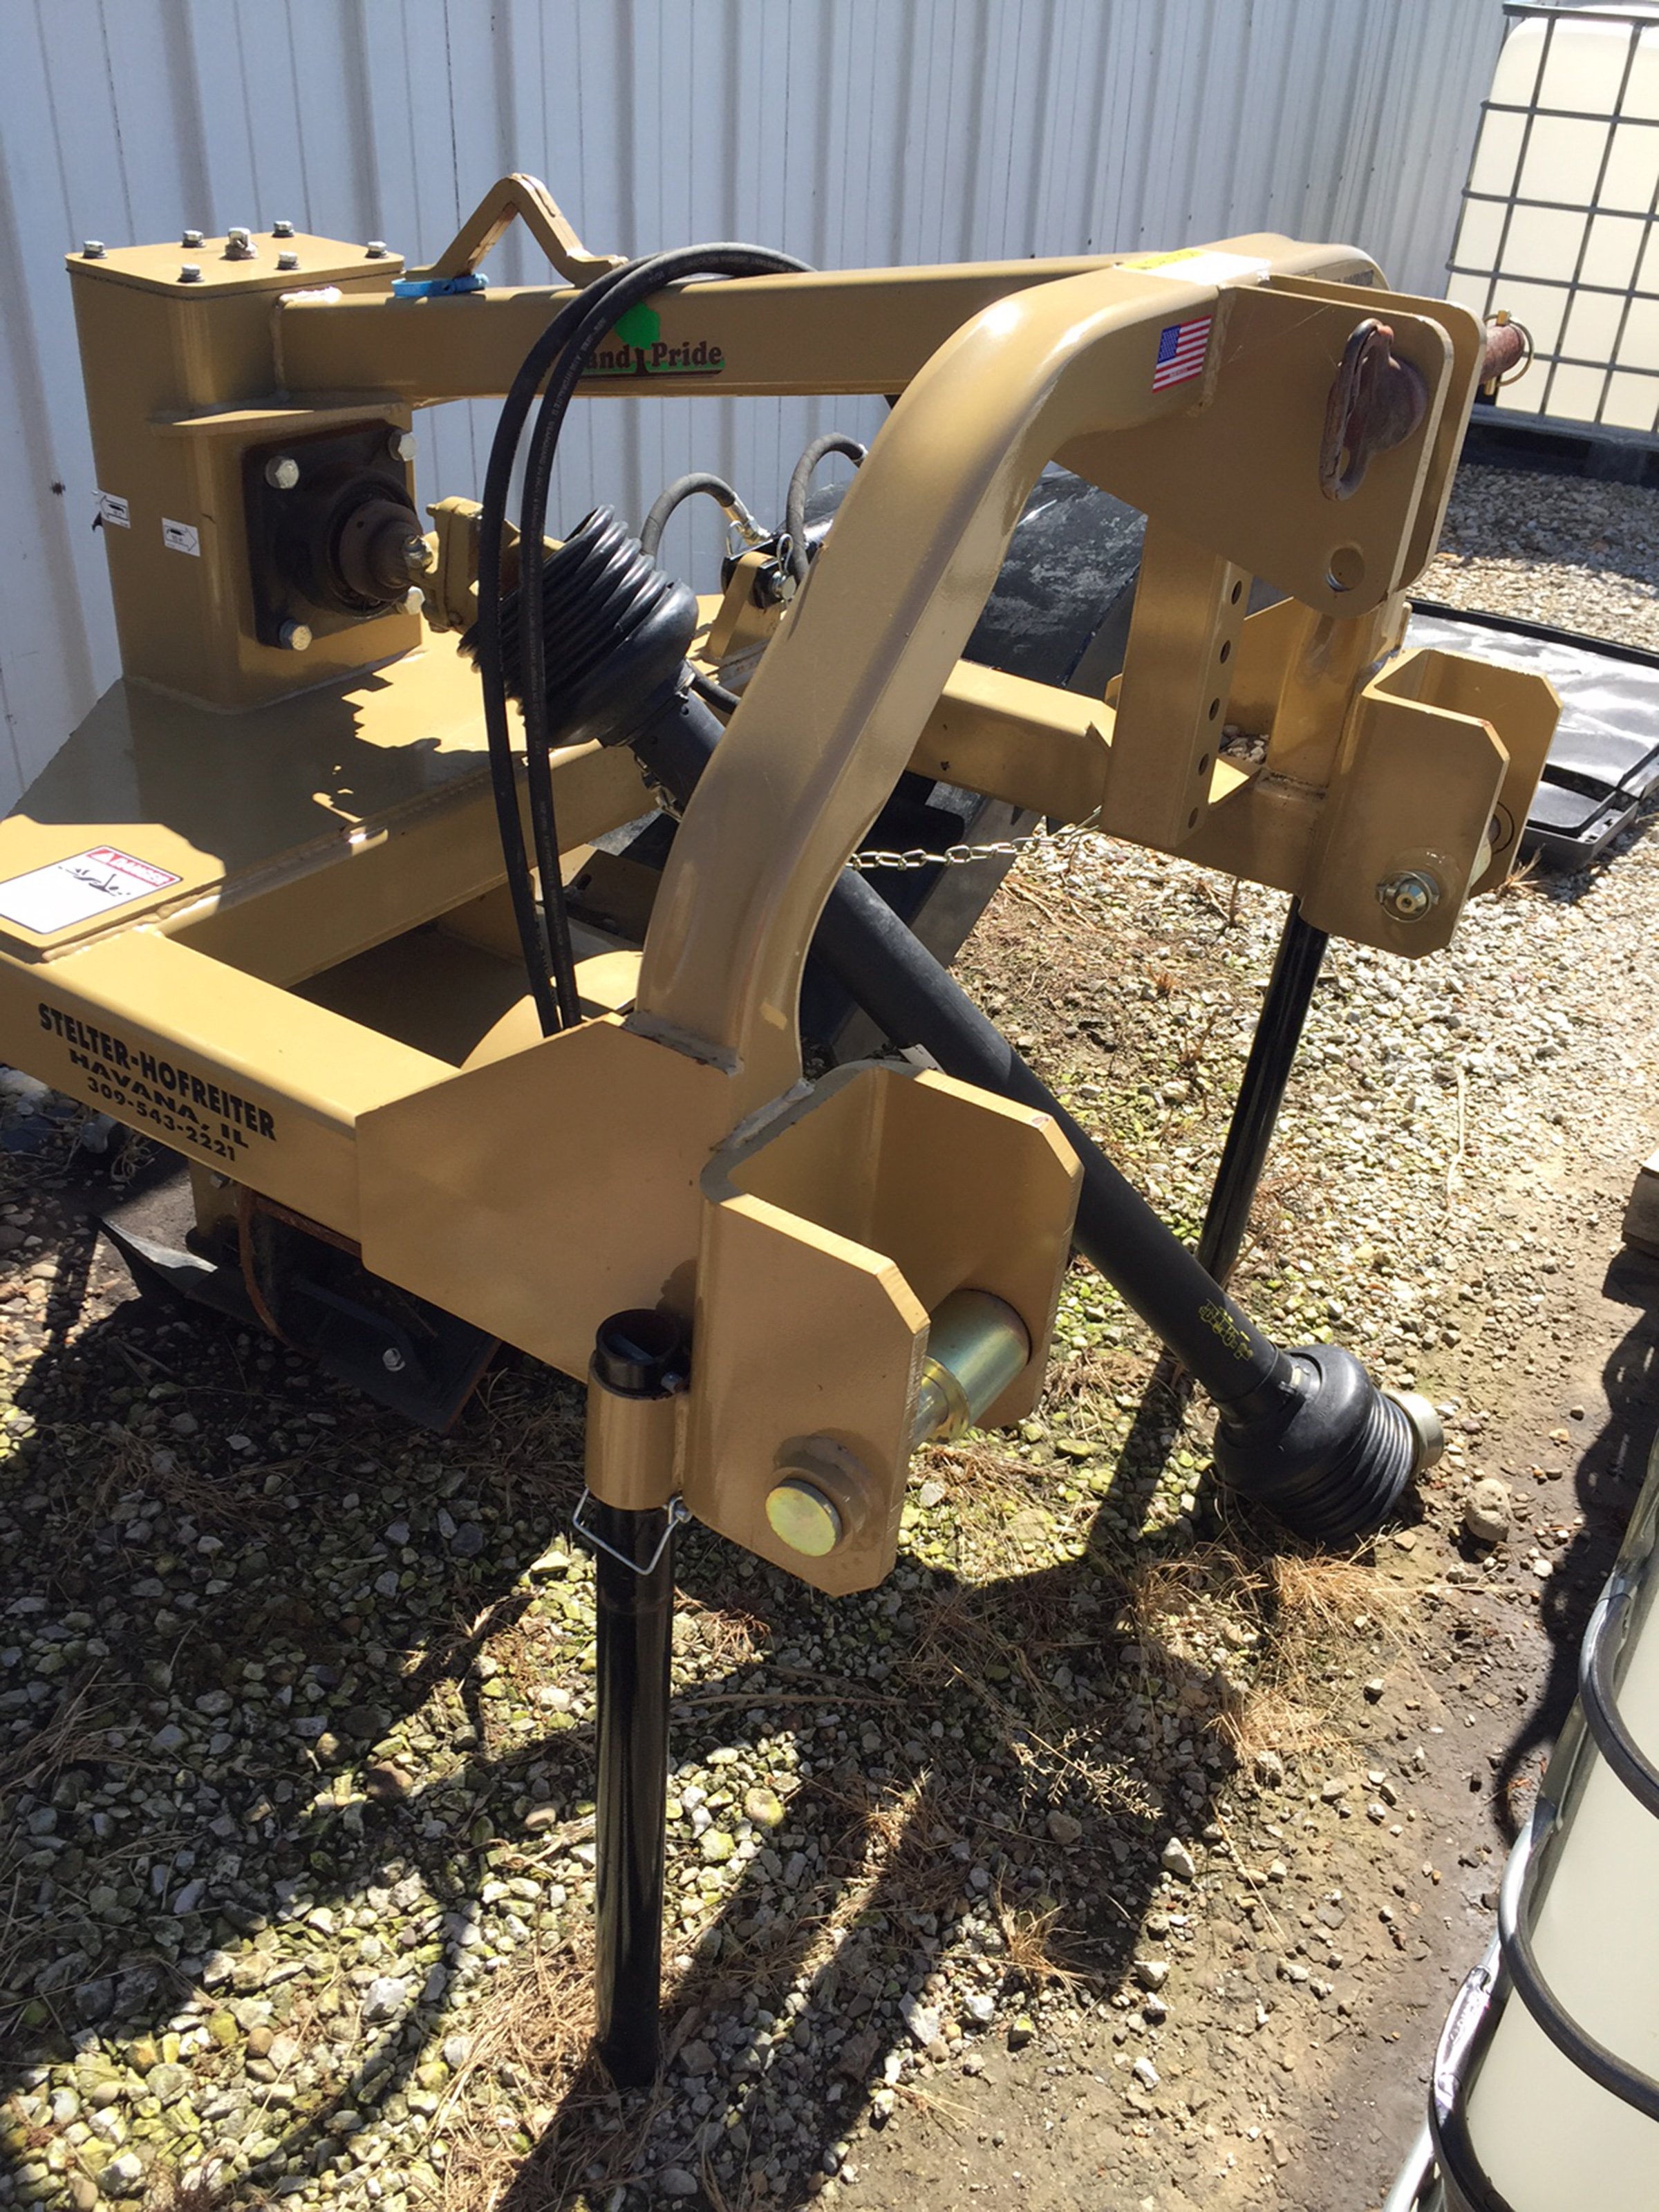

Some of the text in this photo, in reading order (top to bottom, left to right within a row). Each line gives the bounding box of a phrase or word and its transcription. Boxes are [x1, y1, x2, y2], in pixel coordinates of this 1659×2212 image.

[586, 340, 722, 369] and Pride
[38, 1002, 276, 1141] STELTER-HOFREITER
[69, 1048, 249, 1148] HAVANA, IL
[87, 1076, 236, 1161] 309-543-2221
